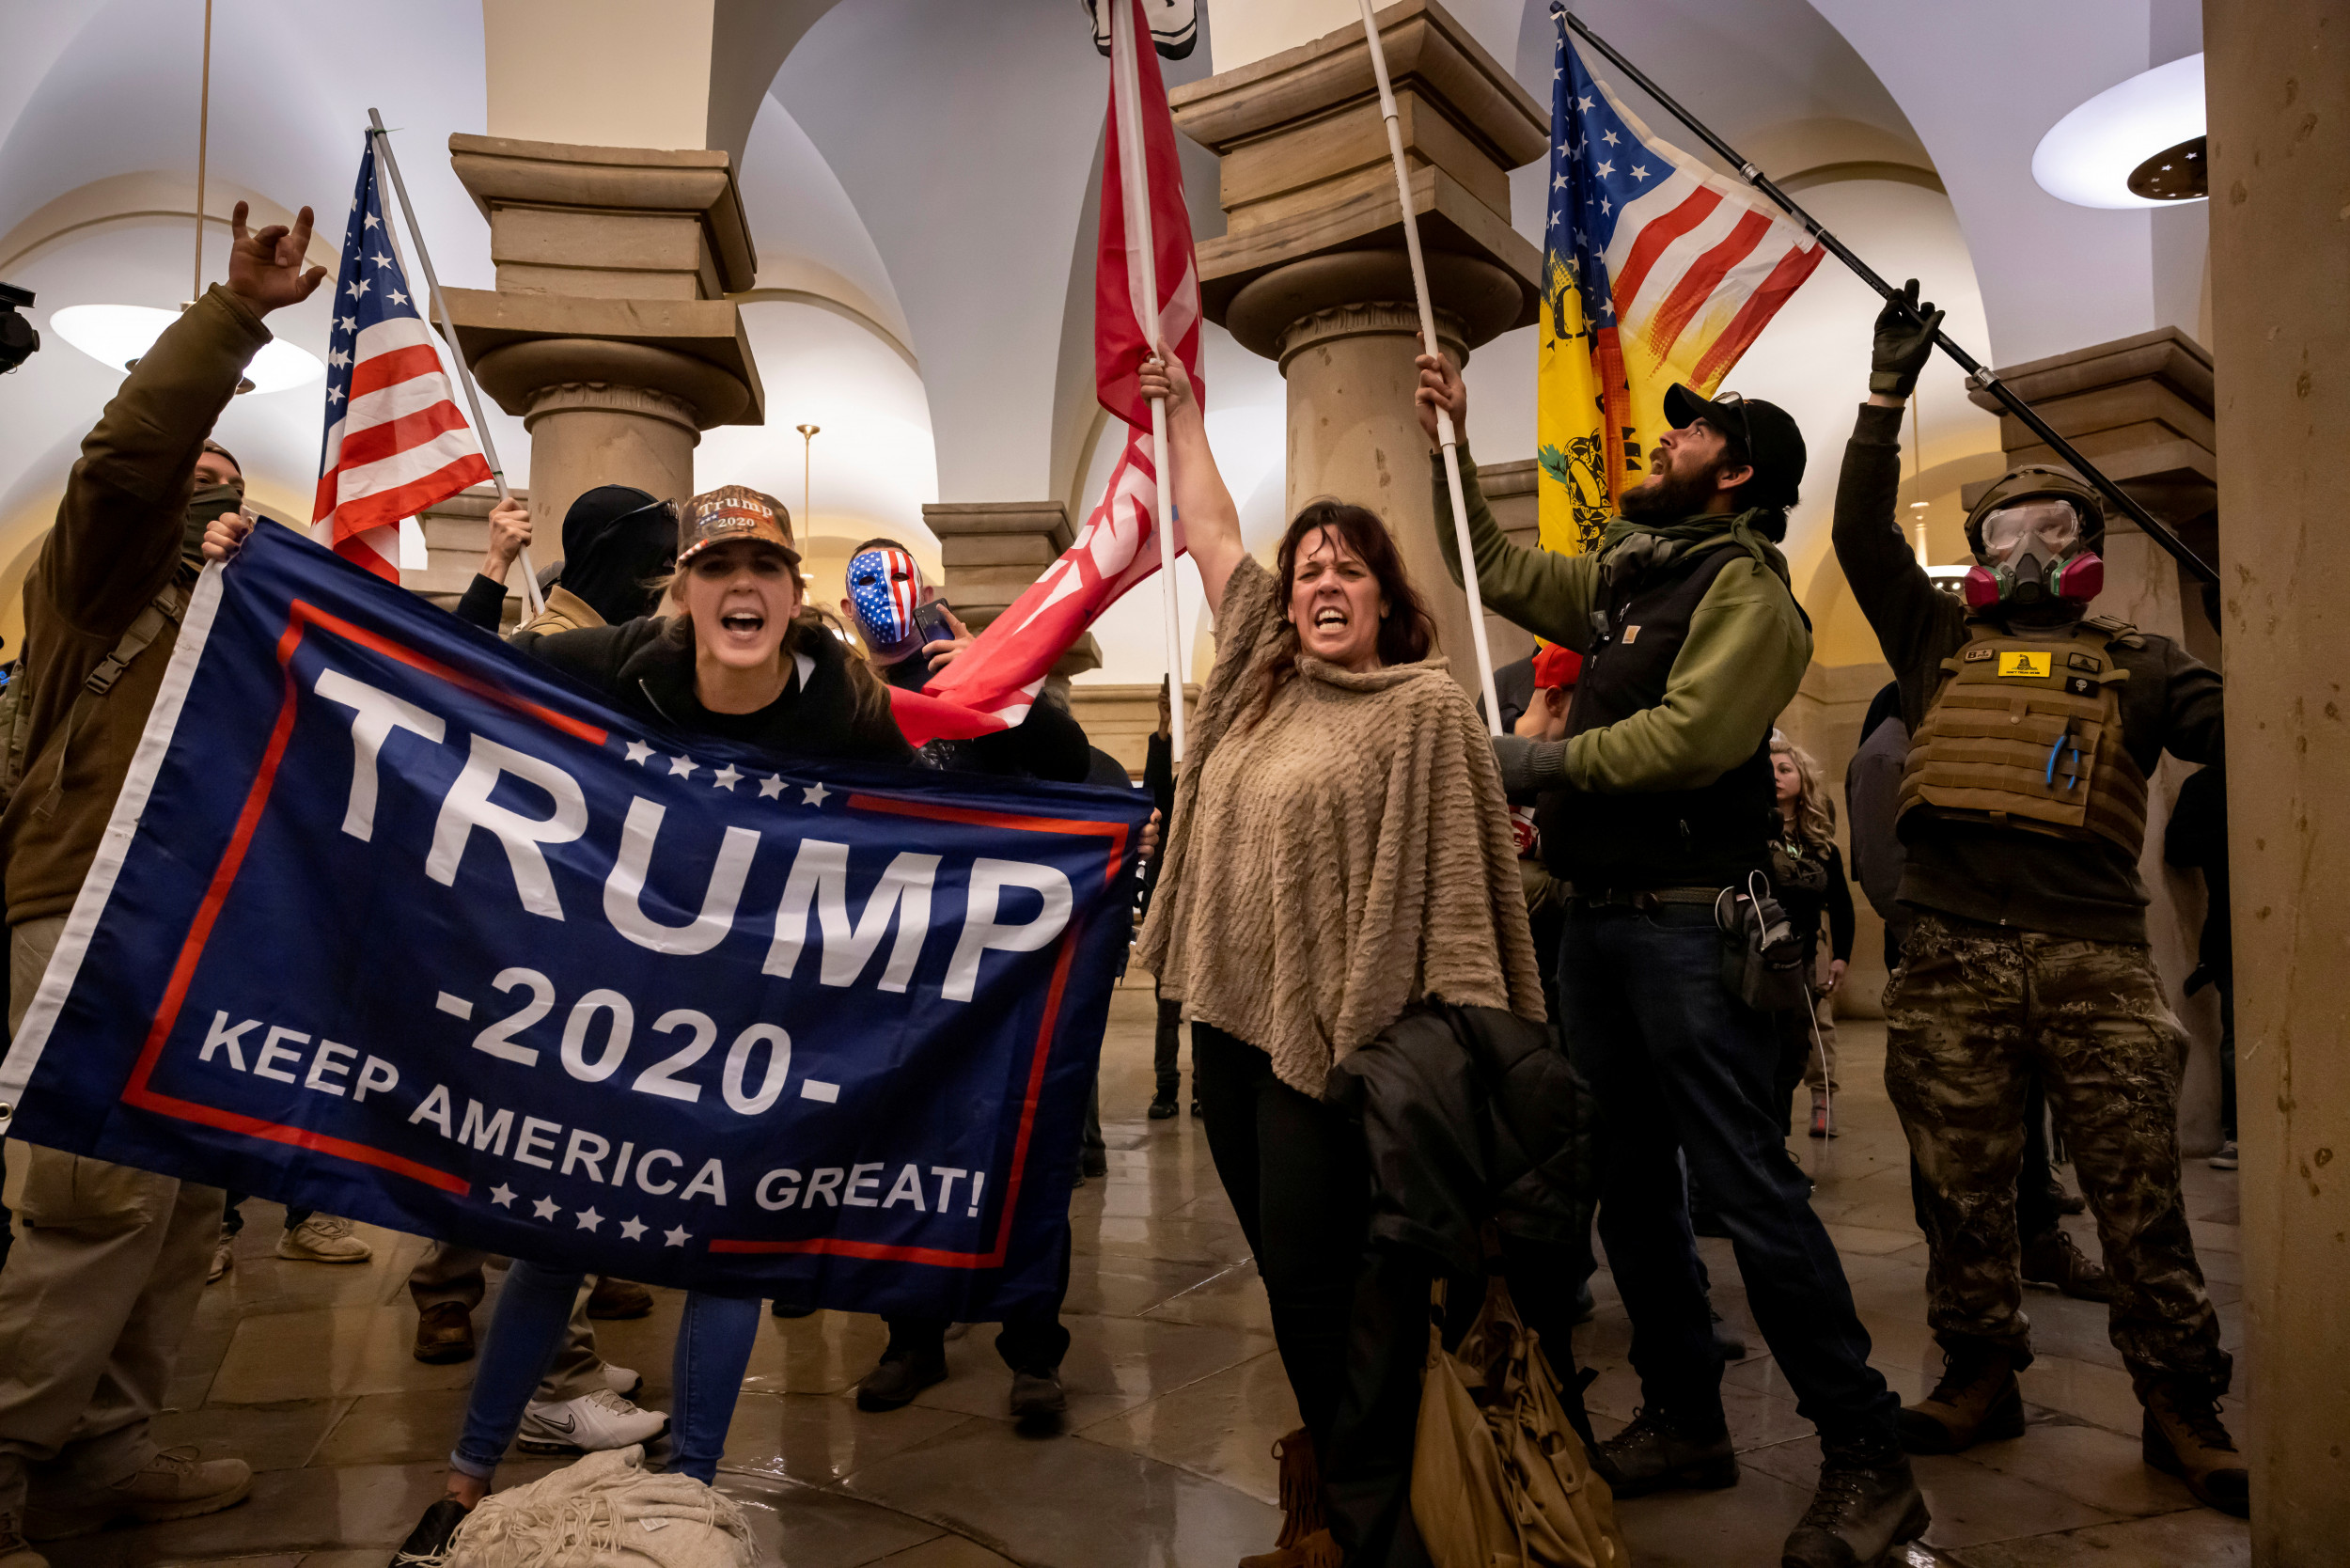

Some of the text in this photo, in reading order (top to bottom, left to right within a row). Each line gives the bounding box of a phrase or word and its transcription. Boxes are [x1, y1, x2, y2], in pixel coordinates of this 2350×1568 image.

[699, 497, 773, 518] Trump
[718, 517, 755, 528] 2020
[313, 667, 1073, 1003] TRUMP
[198, 1010, 985, 1218] KEEP AMERICA GREAT!
[435, 966, 840, 1116] -2020-
